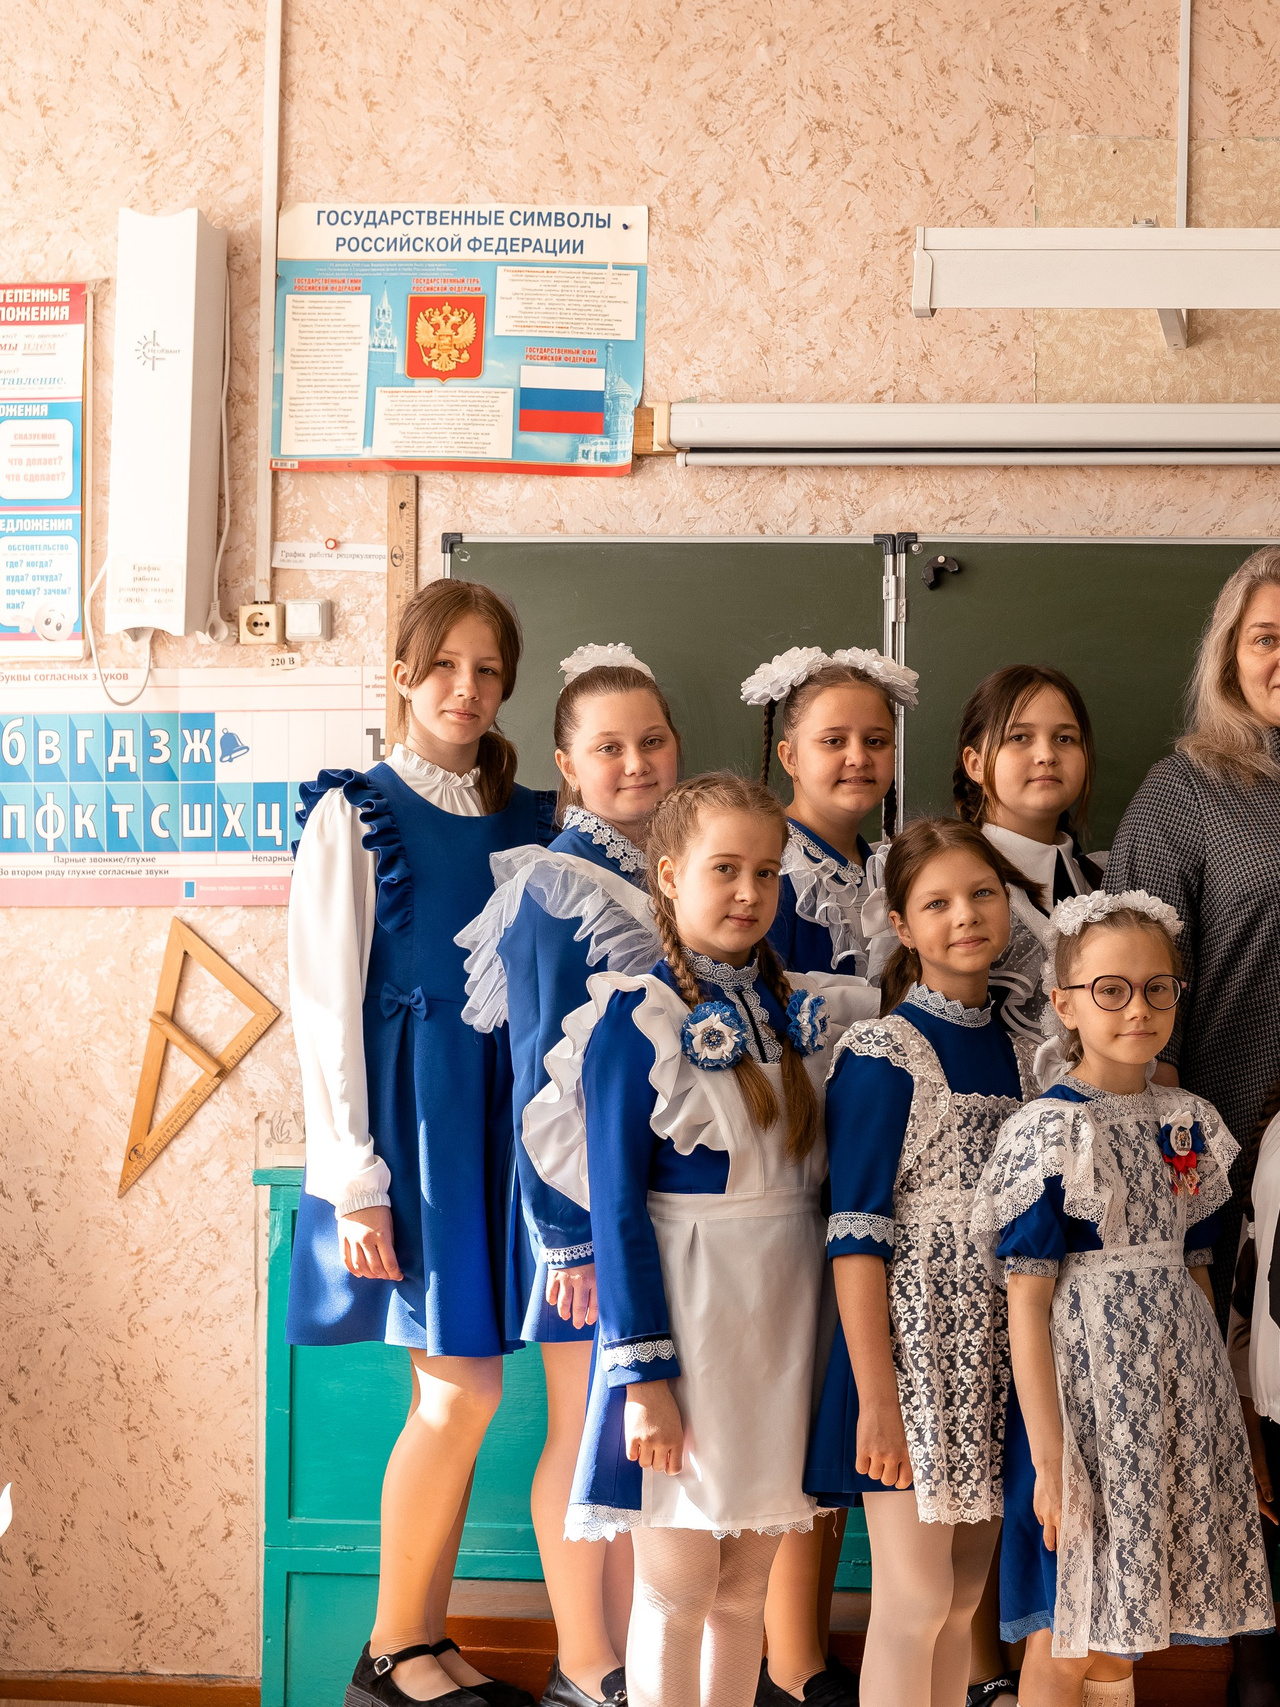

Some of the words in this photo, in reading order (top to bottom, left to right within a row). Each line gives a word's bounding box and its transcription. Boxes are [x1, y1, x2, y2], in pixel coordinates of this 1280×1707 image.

[316, 210, 505, 229] ГОСУДАРСТВЕННЫЕ
[509, 210, 611, 229] СИМВОЛЫ
[335, 233, 462, 252] РОССИЙСКОЙ
[467, 236, 584, 256] ФЕДЕРАЦИИ
[525, 347, 581, 355] ГОСУДАРСТВЕННЫЙ
[525, 354, 562, 362] РОССИЙСКОЙ
[8, 458, 23, 466] что
[26, 457, 63, 467] делает?
[5, 473, 21, 482] что
[24, 472, 66, 483] сделает?
[8, 544, 69, 552] ОБСТОЯТЕЛЬСТВО
[280, 550, 306, 559] График
[309, 551, 333, 559] работы
[6, 560, 24, 569] где?
[26, 559, 53, 569] когда?
[6, 573, 29, 583] куда?
[32, 573, 63, 583] откуда?
[6, 587, 41, 597] почему?
[43, 587, 72, 596] зачем?
[6, 601, 25, 610] как?
[270, 657, 286, 666] 220
[288, 656, 295, 665] В
[34, 673, 88, 682] согласных
[1, 716, 27, 766] б
[37, 729, 62, 765] в
[75, 729, 94, 765] г
[107, 728, 138, 773] д
[148, 728, 172, 764] з
[181, 728, 213, 764] ж
[2, 804, 26, 839] п
[34, 791, 66, 852] ф
[74, 803, 98, 839] к
[111, 803, 135, 839] т
[150, 803, 170, 839] с
[182, 803, 213, 838] ш
[222, 803, 246, 838] х
[257, 803, 283, 846] ц
[53, 855, 87, 865] Парные
[89, 855, 157, 865] звонкие/глухие
[11, 869, 43, 878] втором
[45, 869, 65, 877] ряду
[67, 868, 96, 877] глухие
[98, 868, 142, 877] согласные
[145, 868, 169, 877] звуки
